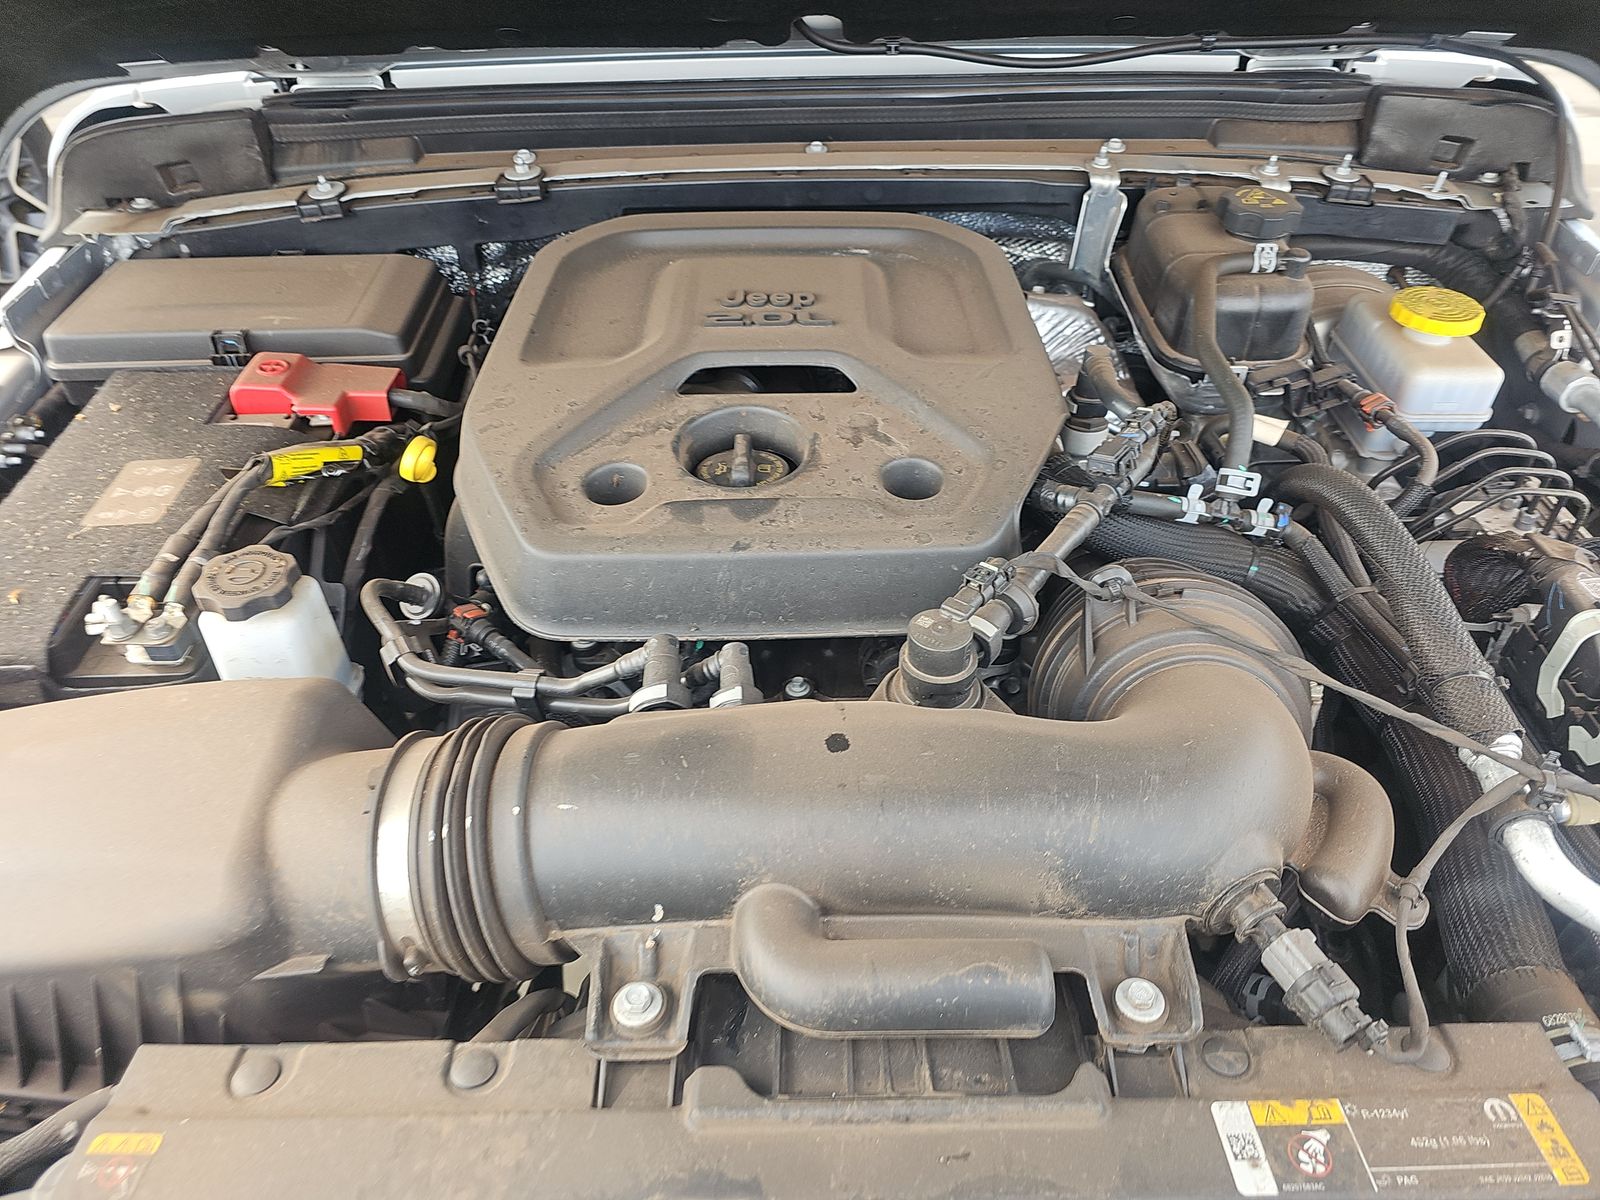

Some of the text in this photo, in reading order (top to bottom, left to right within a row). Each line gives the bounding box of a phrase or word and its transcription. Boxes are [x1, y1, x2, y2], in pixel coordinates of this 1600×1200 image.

[719, 289, 817, 310] Jeep
[703, 310, 834, 328] 2.0L
[1395, 1174, 1420, 1186] PAG
